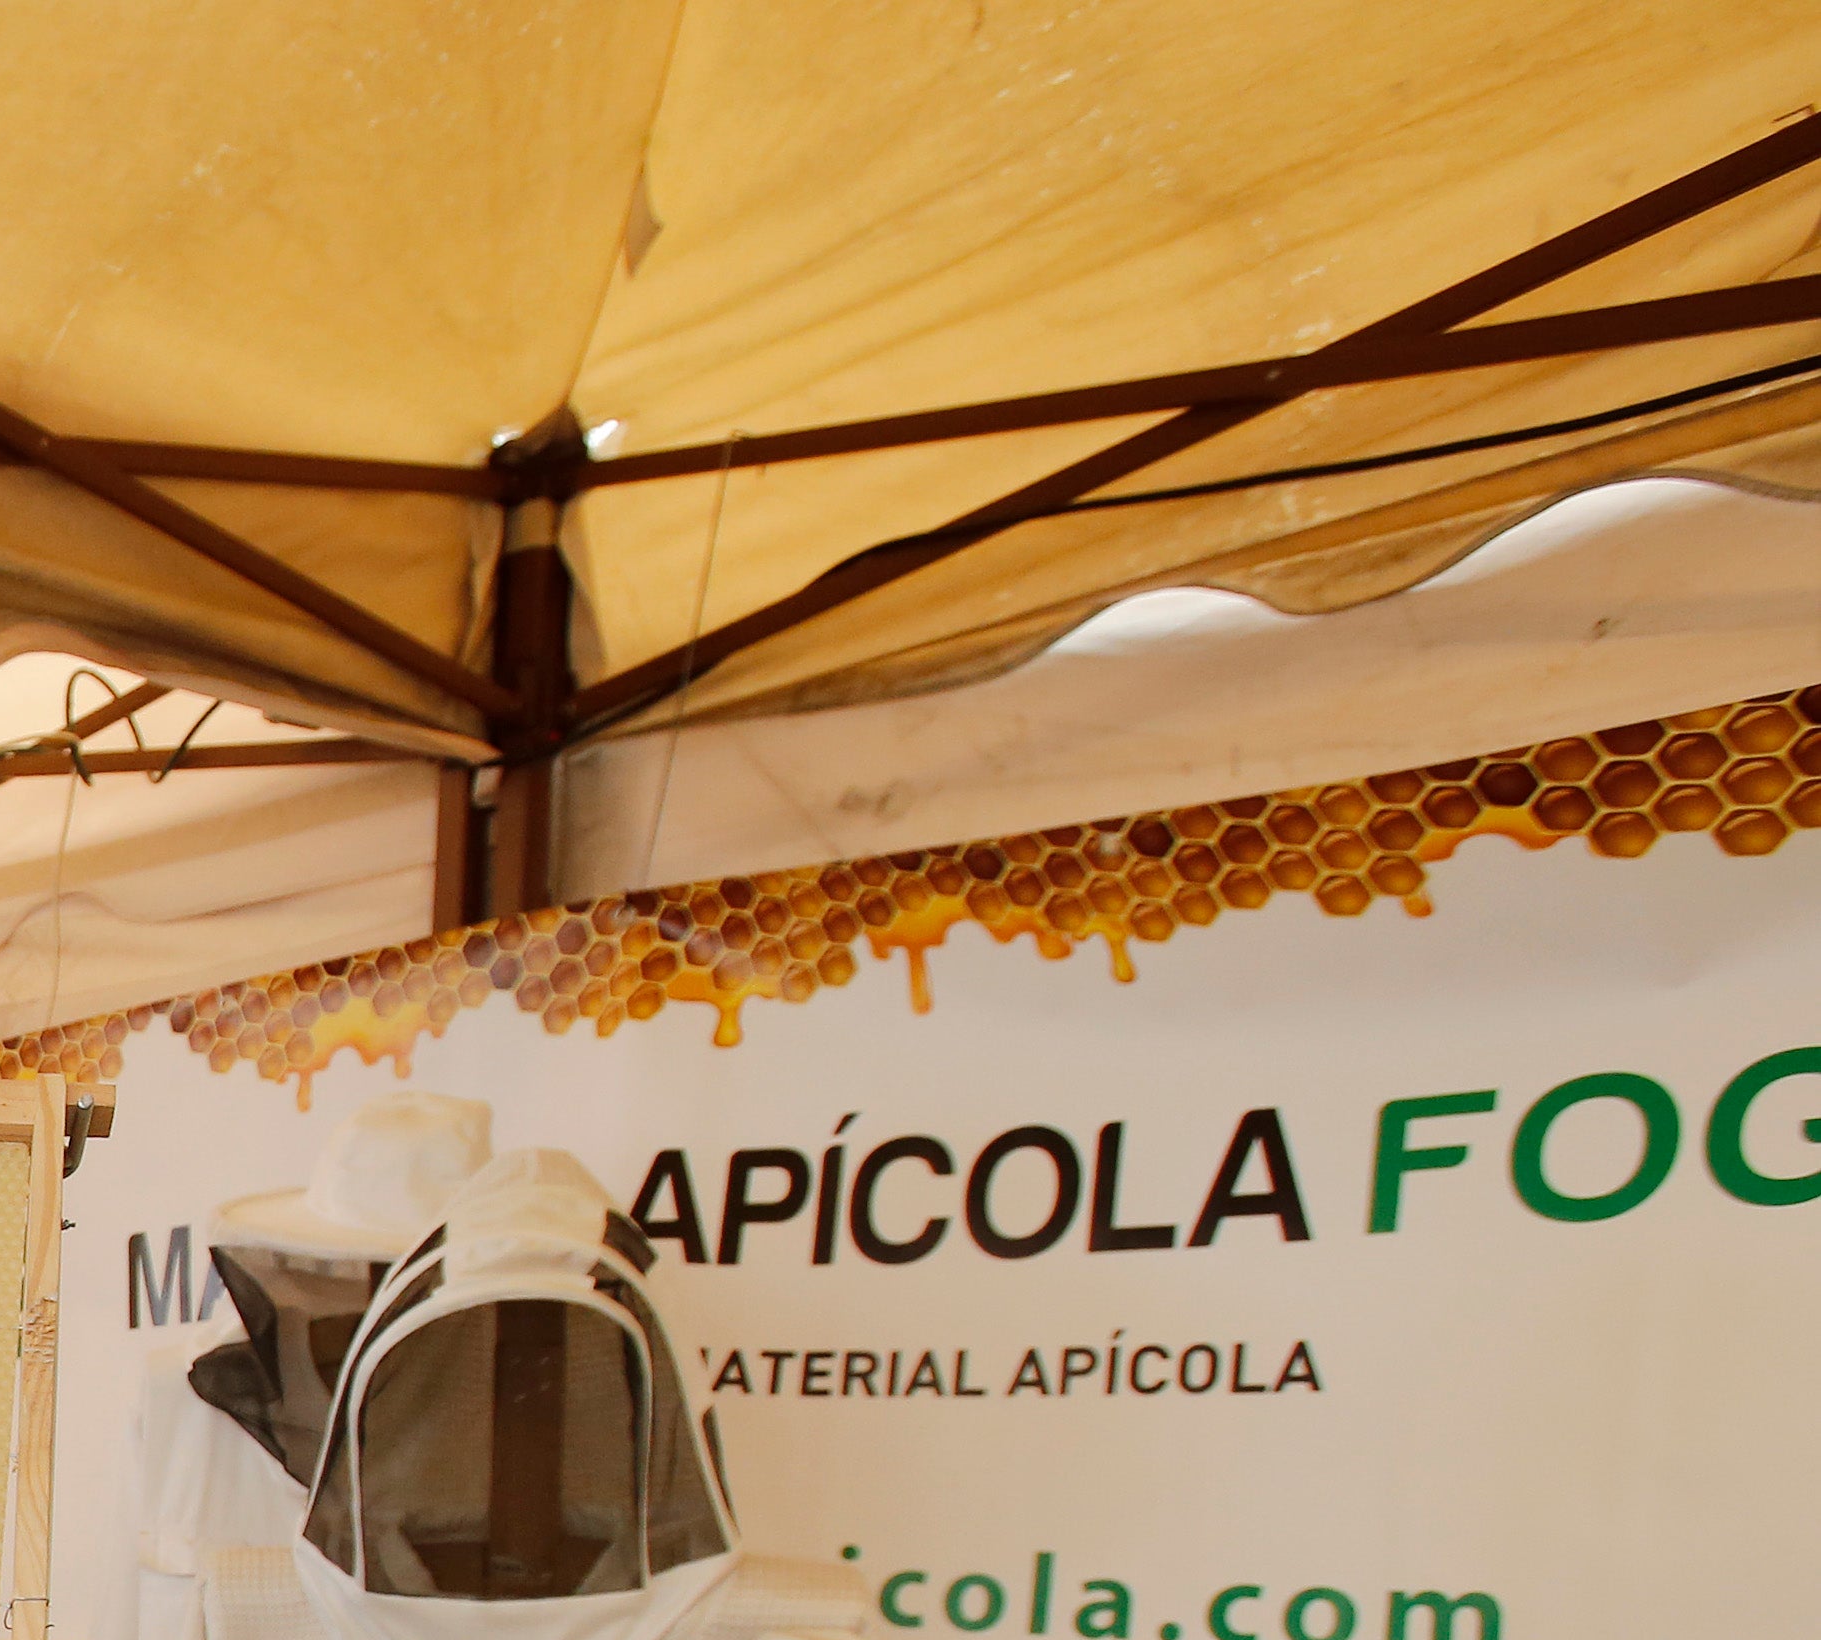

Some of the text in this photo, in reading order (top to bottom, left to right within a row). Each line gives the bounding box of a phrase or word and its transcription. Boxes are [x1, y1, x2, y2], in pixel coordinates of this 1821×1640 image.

[629, 1108, 1312, 1265] APÍCOLA
[700, 1329, 1323, 1397] ATERIAL APÍCOLA
